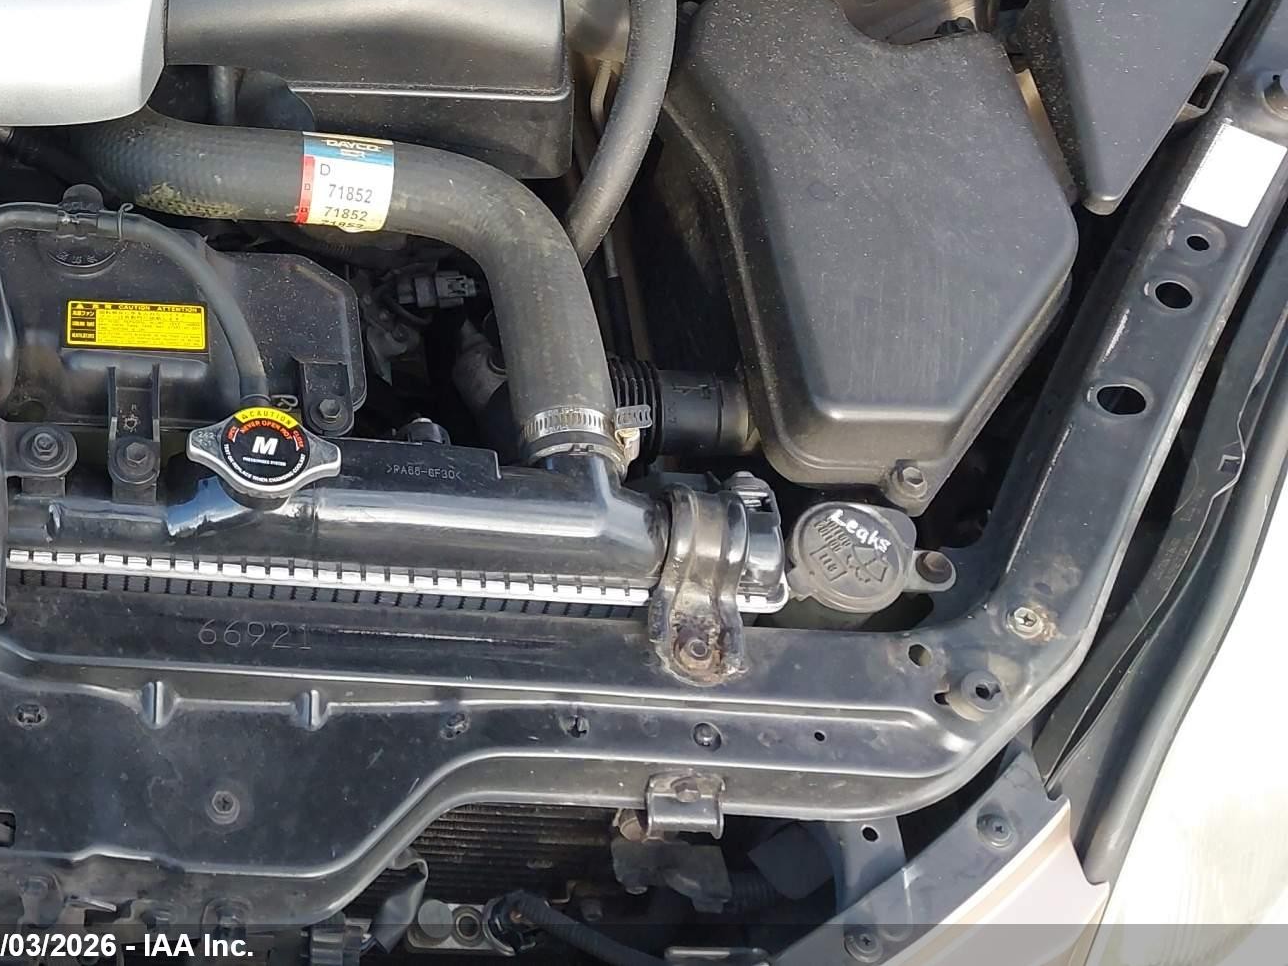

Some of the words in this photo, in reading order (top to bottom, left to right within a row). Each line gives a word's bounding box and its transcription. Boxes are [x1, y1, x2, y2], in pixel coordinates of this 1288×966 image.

[326, 139, 380, 152] DAYCO
[320, 163, 330, 176] D
[329, 184, 373, 204] 71852
[324, 206, 369, 222] 71852
[249, 410, 292, 425] CAUTION
[240, 420, 261, 434] NEVER
[261, 420, 281, 431] OPEN
[251, 436, 279, 455] M
[198, 619, 312, 650] 66921
